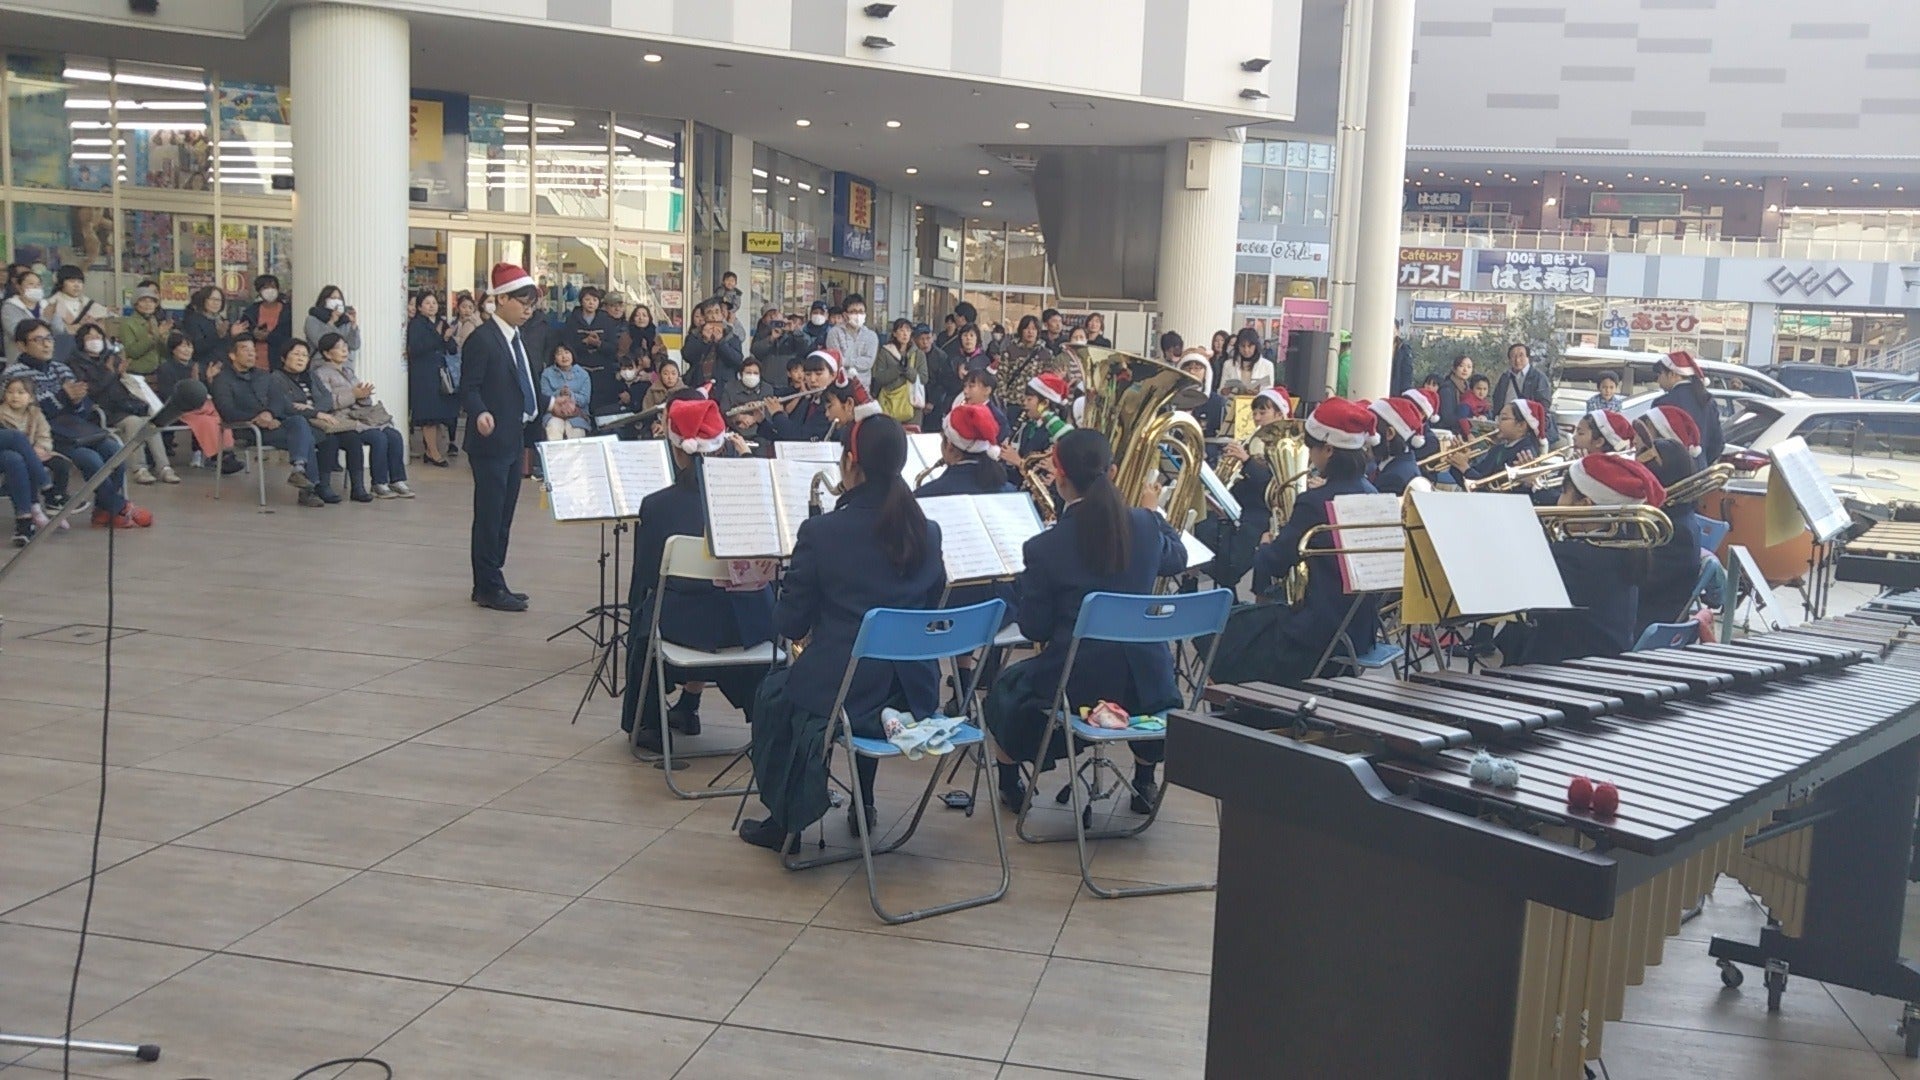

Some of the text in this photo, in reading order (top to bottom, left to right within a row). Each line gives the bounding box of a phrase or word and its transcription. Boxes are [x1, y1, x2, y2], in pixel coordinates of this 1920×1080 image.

[1400, 262, 1460, 286] ガスト
[1492, 264, 1595, 293] はま寿司
[1766, 265, 1854, 297] GEO
[1631, 312, 1699, 332] あさひ
